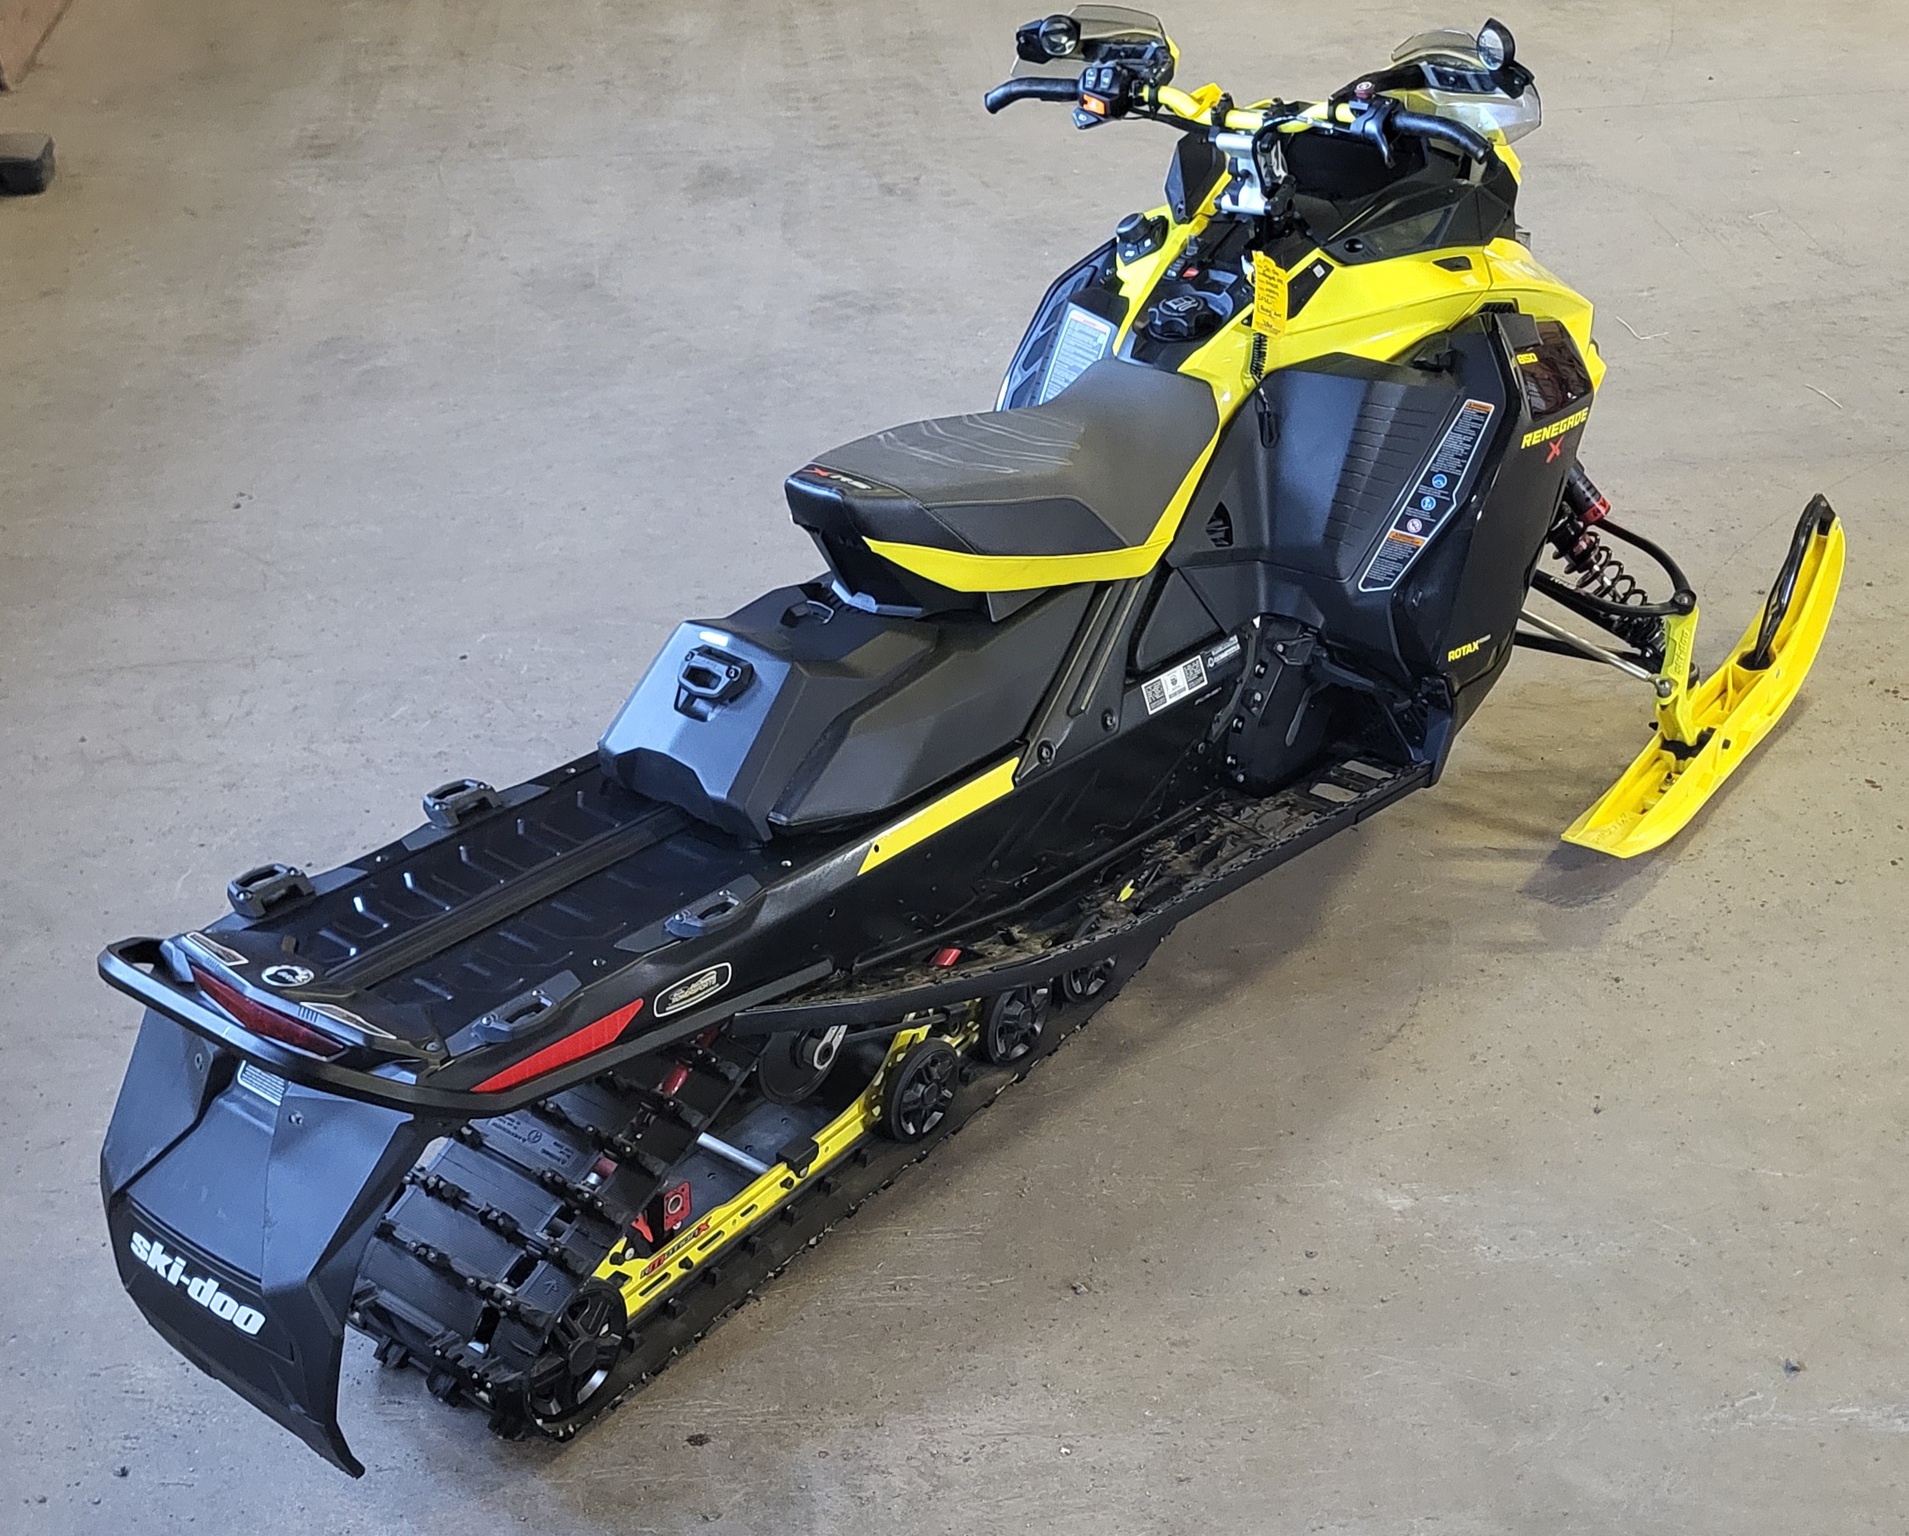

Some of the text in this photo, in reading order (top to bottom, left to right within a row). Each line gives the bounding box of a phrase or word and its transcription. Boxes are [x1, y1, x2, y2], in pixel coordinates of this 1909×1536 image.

[1521, 406, 1589, 449] RENEGADE
[1545, 434, 1565, 464] X
[1447, 640, 1480, 662] ROTAX
[130, 1231, 267, 1336] ski-doo
